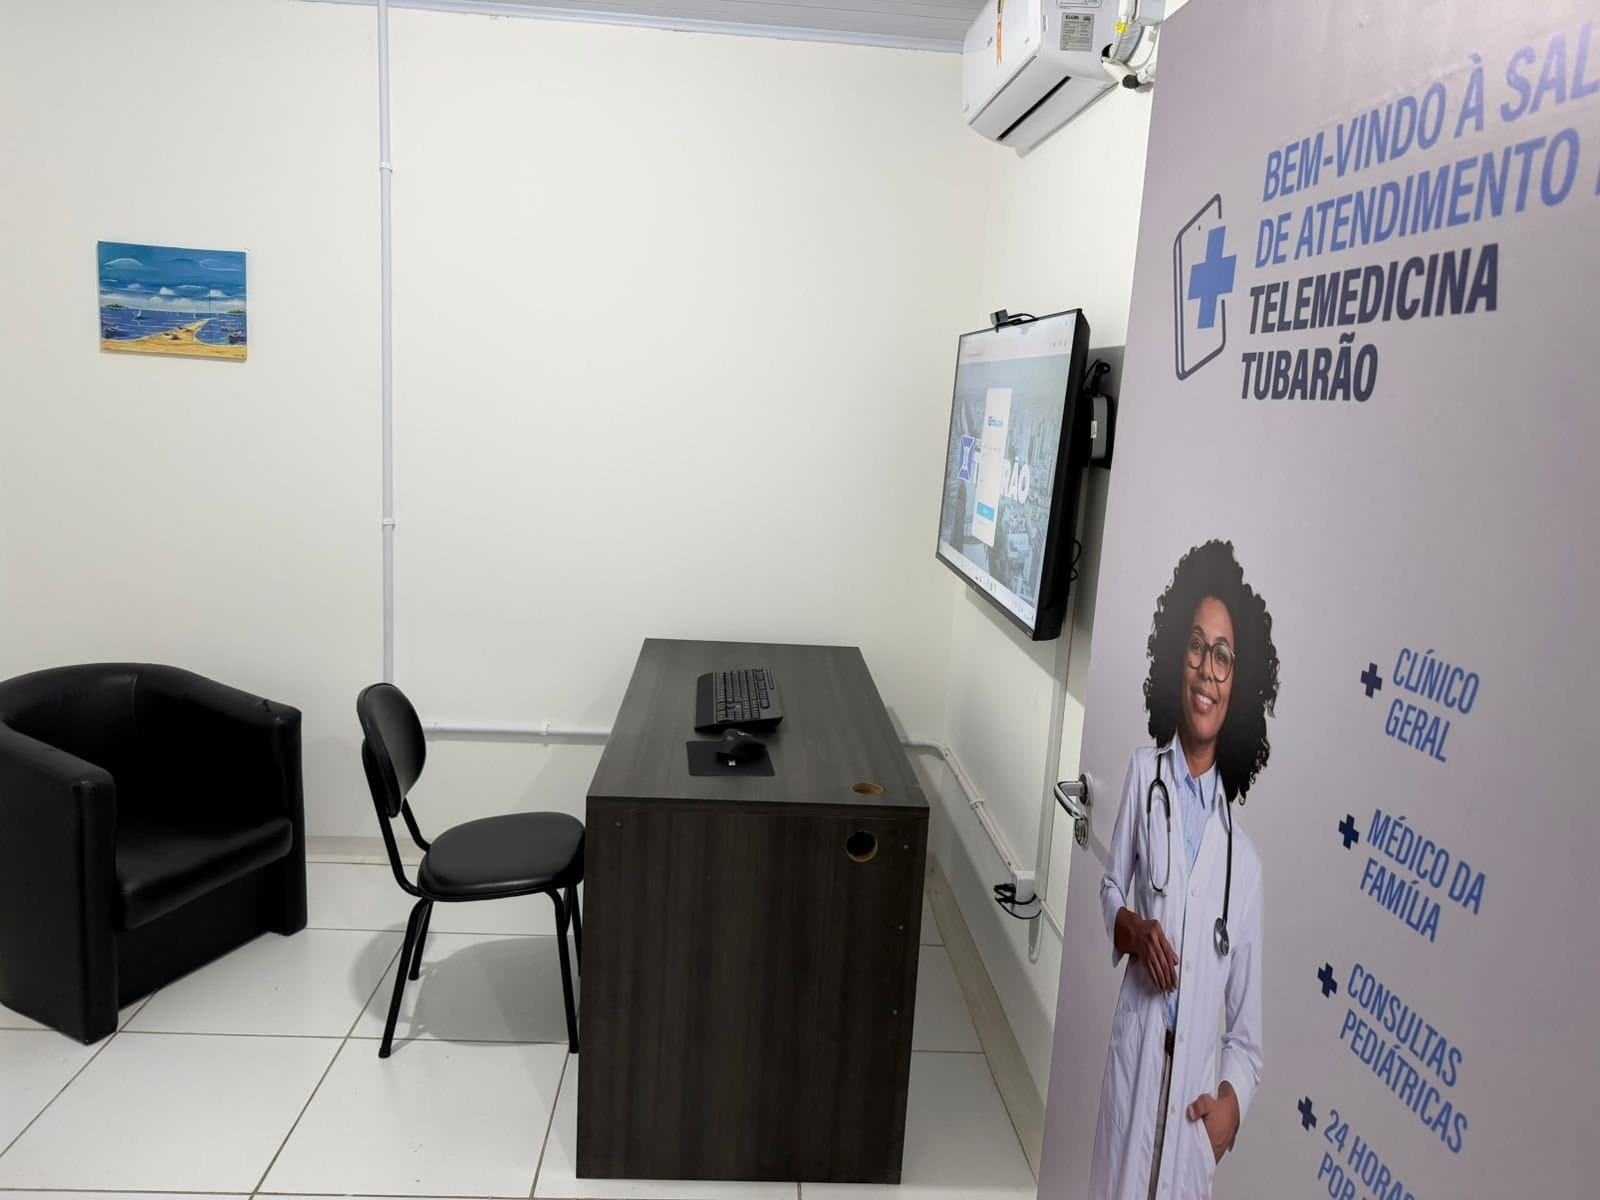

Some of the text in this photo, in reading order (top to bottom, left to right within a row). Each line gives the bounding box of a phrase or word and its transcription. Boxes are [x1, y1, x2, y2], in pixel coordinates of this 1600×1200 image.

[1263, 82, 1446, 202] BEM-VINDO
[1453, 53, 1485, 139] À
[1255, 127, 1580, 269] DE ATENDIMENTO
[1249, 243, 1499, 335] TELEMEDICINA
[1241, 332, 1378, 402] TUBARÃO
[1392, 648, 1480, 715] CLÍNICO
[1385, 698, 1450, 763] GERAL
[1359, 857, 1441, 943] FAMÍLIA
[1366, 808, 1486, 915] MÉDICO DA
[1347, 963, 1462, 1087] CONSULTAS
[1340, 1008, 1468, 1154] PEDIÁTRICAS
[1323, 1109, 1415, 1200] 24 HORA
